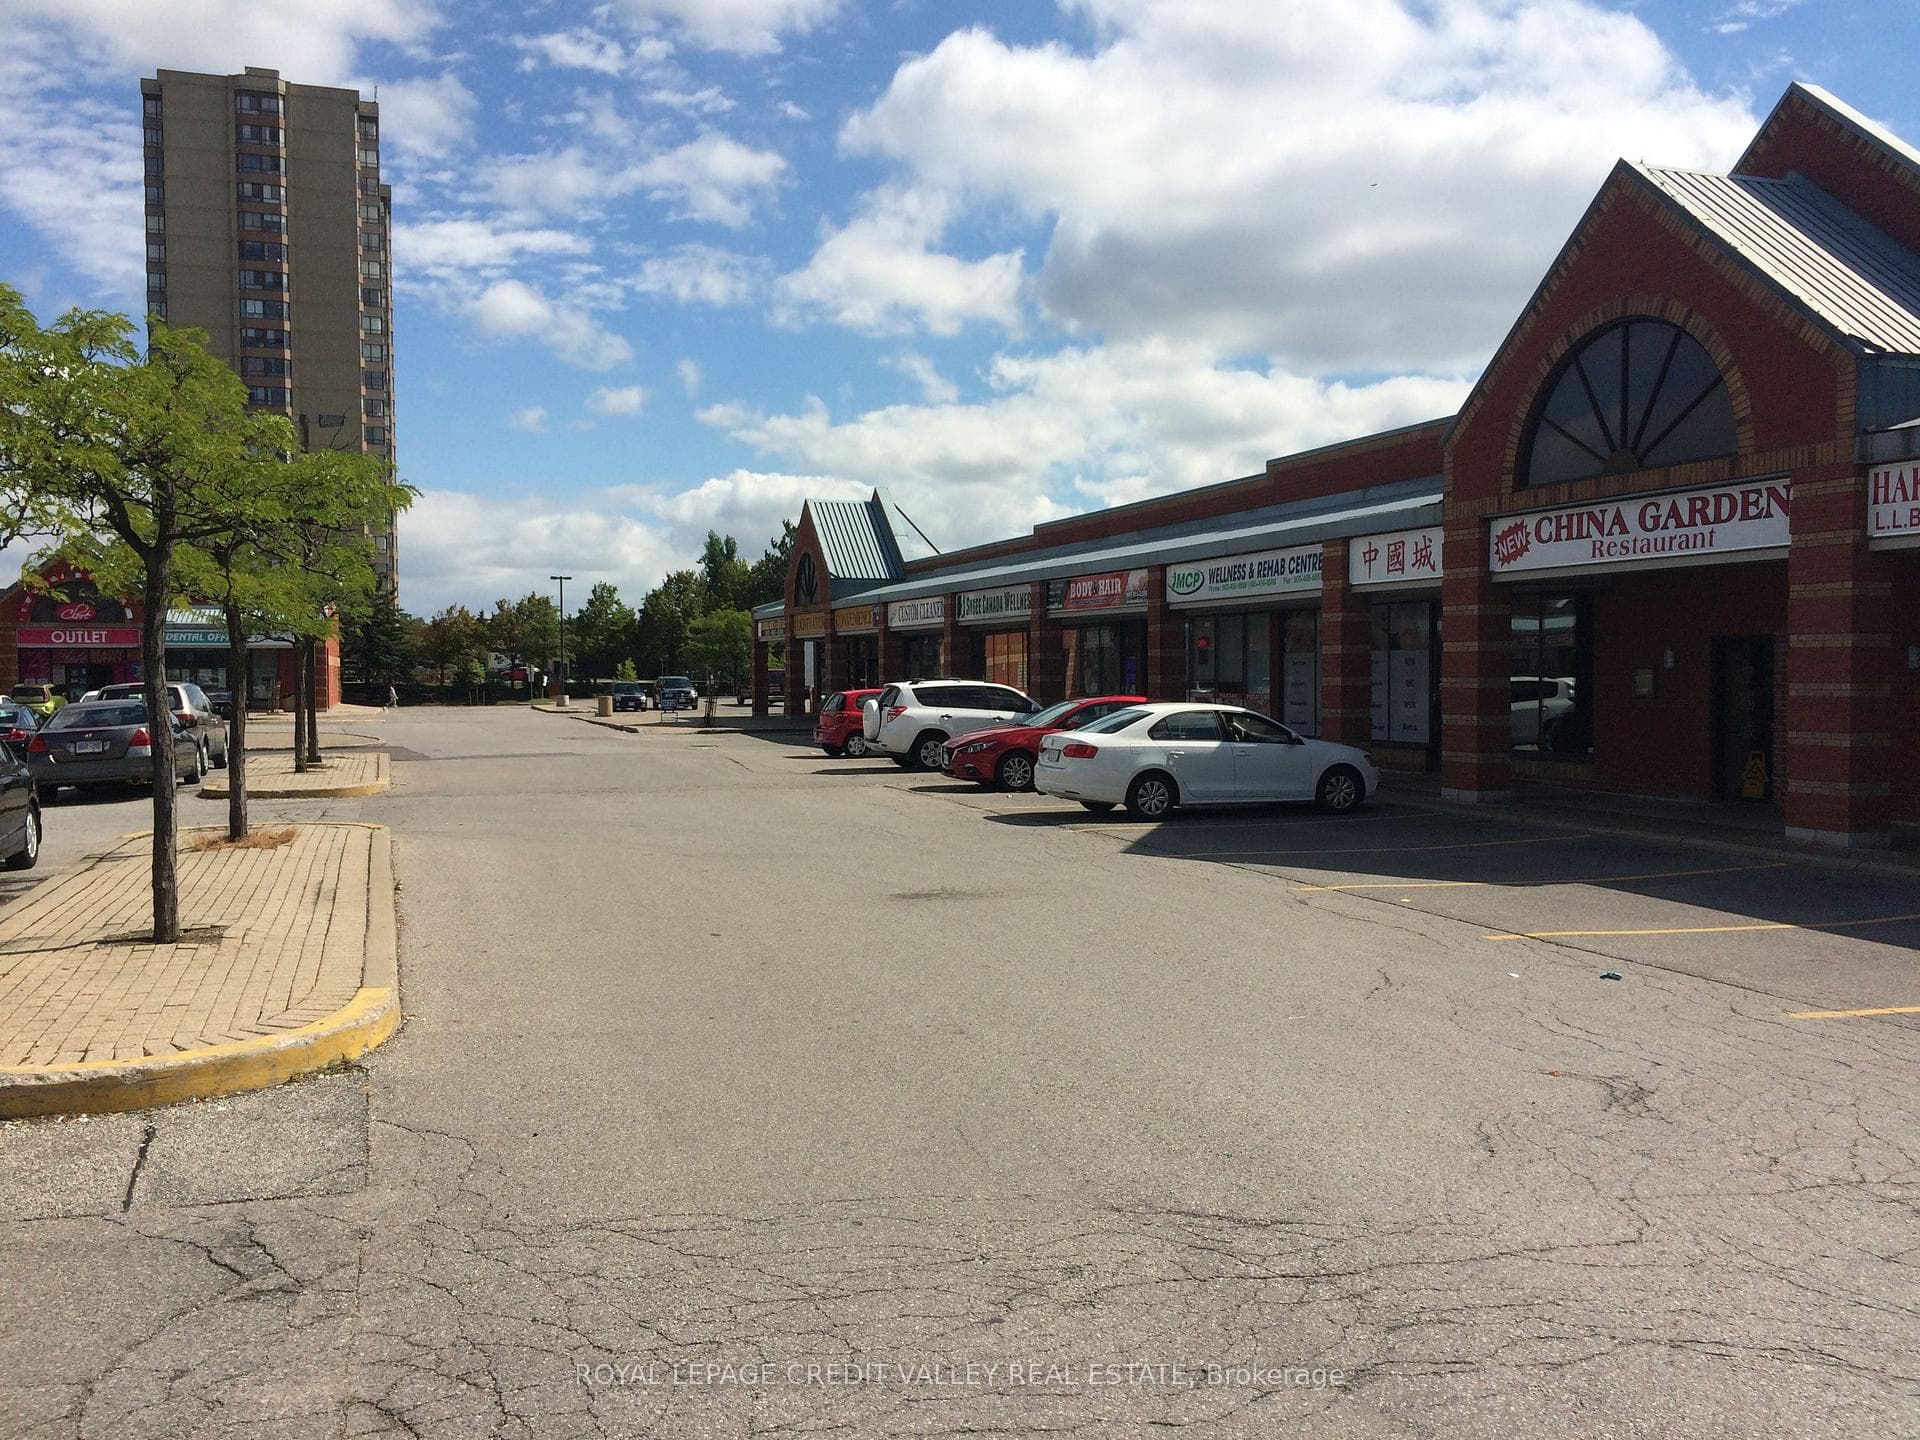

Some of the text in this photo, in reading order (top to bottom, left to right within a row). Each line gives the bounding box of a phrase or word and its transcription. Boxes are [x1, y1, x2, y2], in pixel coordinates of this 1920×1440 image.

[1534, 484, 1793, 545] CHINA GARDEN
[1362, 535, 1437, 579] 中國城
[1498, 530, 1528, 558] NEW
[1591, 528, 1716, 559] Restaurant
[1208, 563, 1247, 585] WELLNESS
[1249, 561, 1255, 579] &
[1257, 557, 1286, 578] REHAB
[1070, 581, 1093, 598] BODY
[1099, 578, 1121, 595] HAIR
[51, 631, 107, 643] OUTLET
[165, 632, 205, 641] DENTAL
